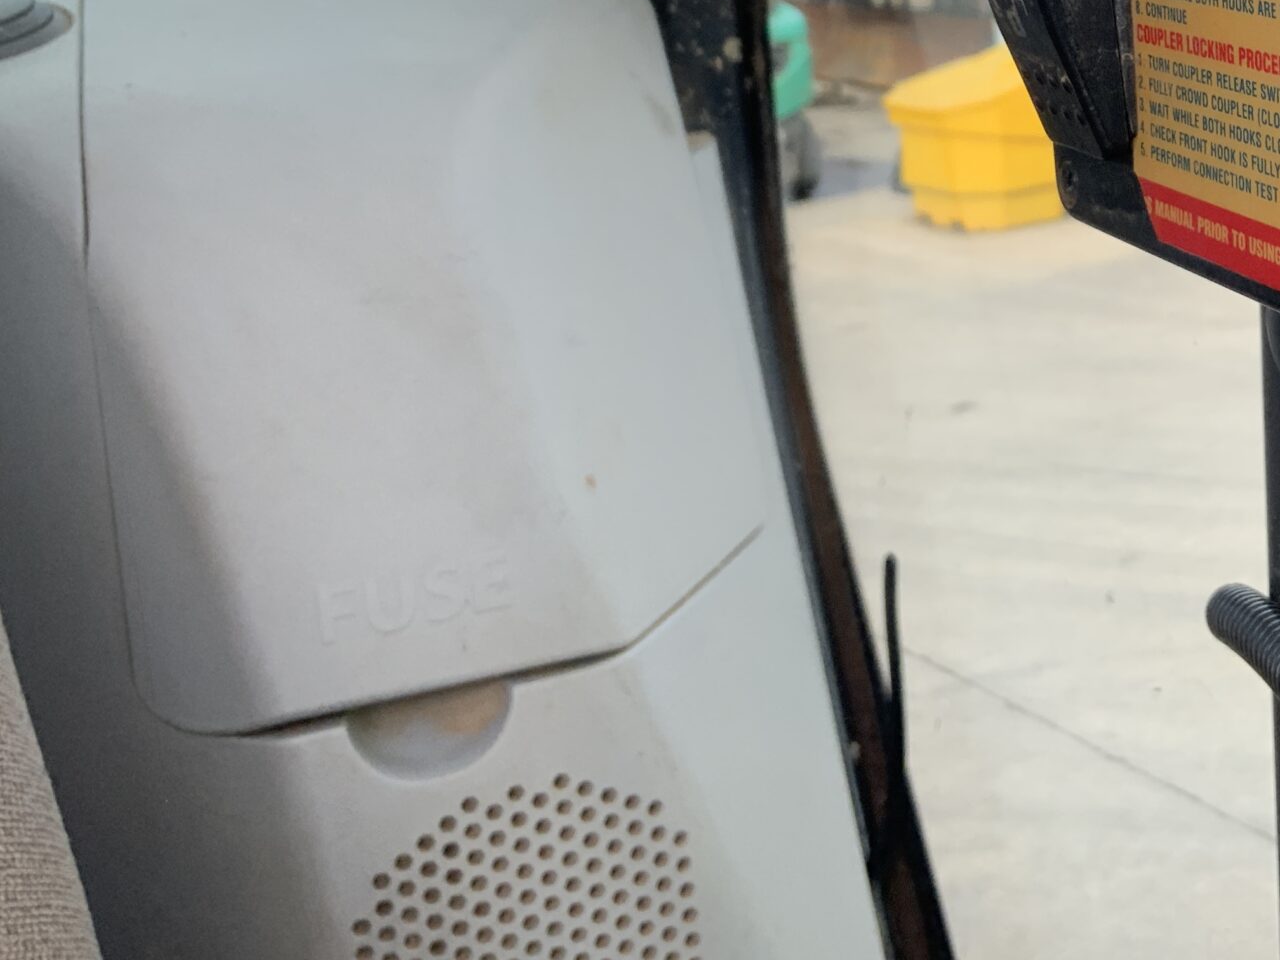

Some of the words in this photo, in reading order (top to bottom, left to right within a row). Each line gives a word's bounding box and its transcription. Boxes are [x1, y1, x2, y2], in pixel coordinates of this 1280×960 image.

[1146, 2, 1187, 25] CONTINUE
[1257, 0, 1276, 19] ARE
[1137, 23, 1183, 52] COUPLER
[1186, 35, 1234, 64] LOCKING
[1148, 54, 1170, 73] TURN
[1172, 61, 1213, 86] COUPLER
[1216, 72, 1257, 97] RELEASE
[1148, 78, 1173, 97] FULLY
[1176, 85, 1208, 108] CROWD
[1211, 95, 1254, 120] COUPLER
[1149, 100, 1169, 120] WAIT
[1172, 107, 1199, 128] WHILE
[1202, 115, 1227, 137] BOTH
[1229, 123, 1262, 148] HOOKS
[1150, 123, 1177, 144] CHECK
[1179, 131, 1208, 155] FRONT
[1210, 142, 1236, 164] HOOK
[1239, 151, 1248, 169] IS
[1251, 154, 1280, 179] FULLY
[1150, 145, 1191, 172] PERFORM
[1193, 160, 1252, 194] CONNECTION
[1255, 180, 1279, 203] TEST
[1154, 198, 1195, 232] MANUAL
[1197, 216, 1230, 245] PRIOR
[1231, 228, 1247, 251] TO
[313, 548, 514, 647] FUSE
